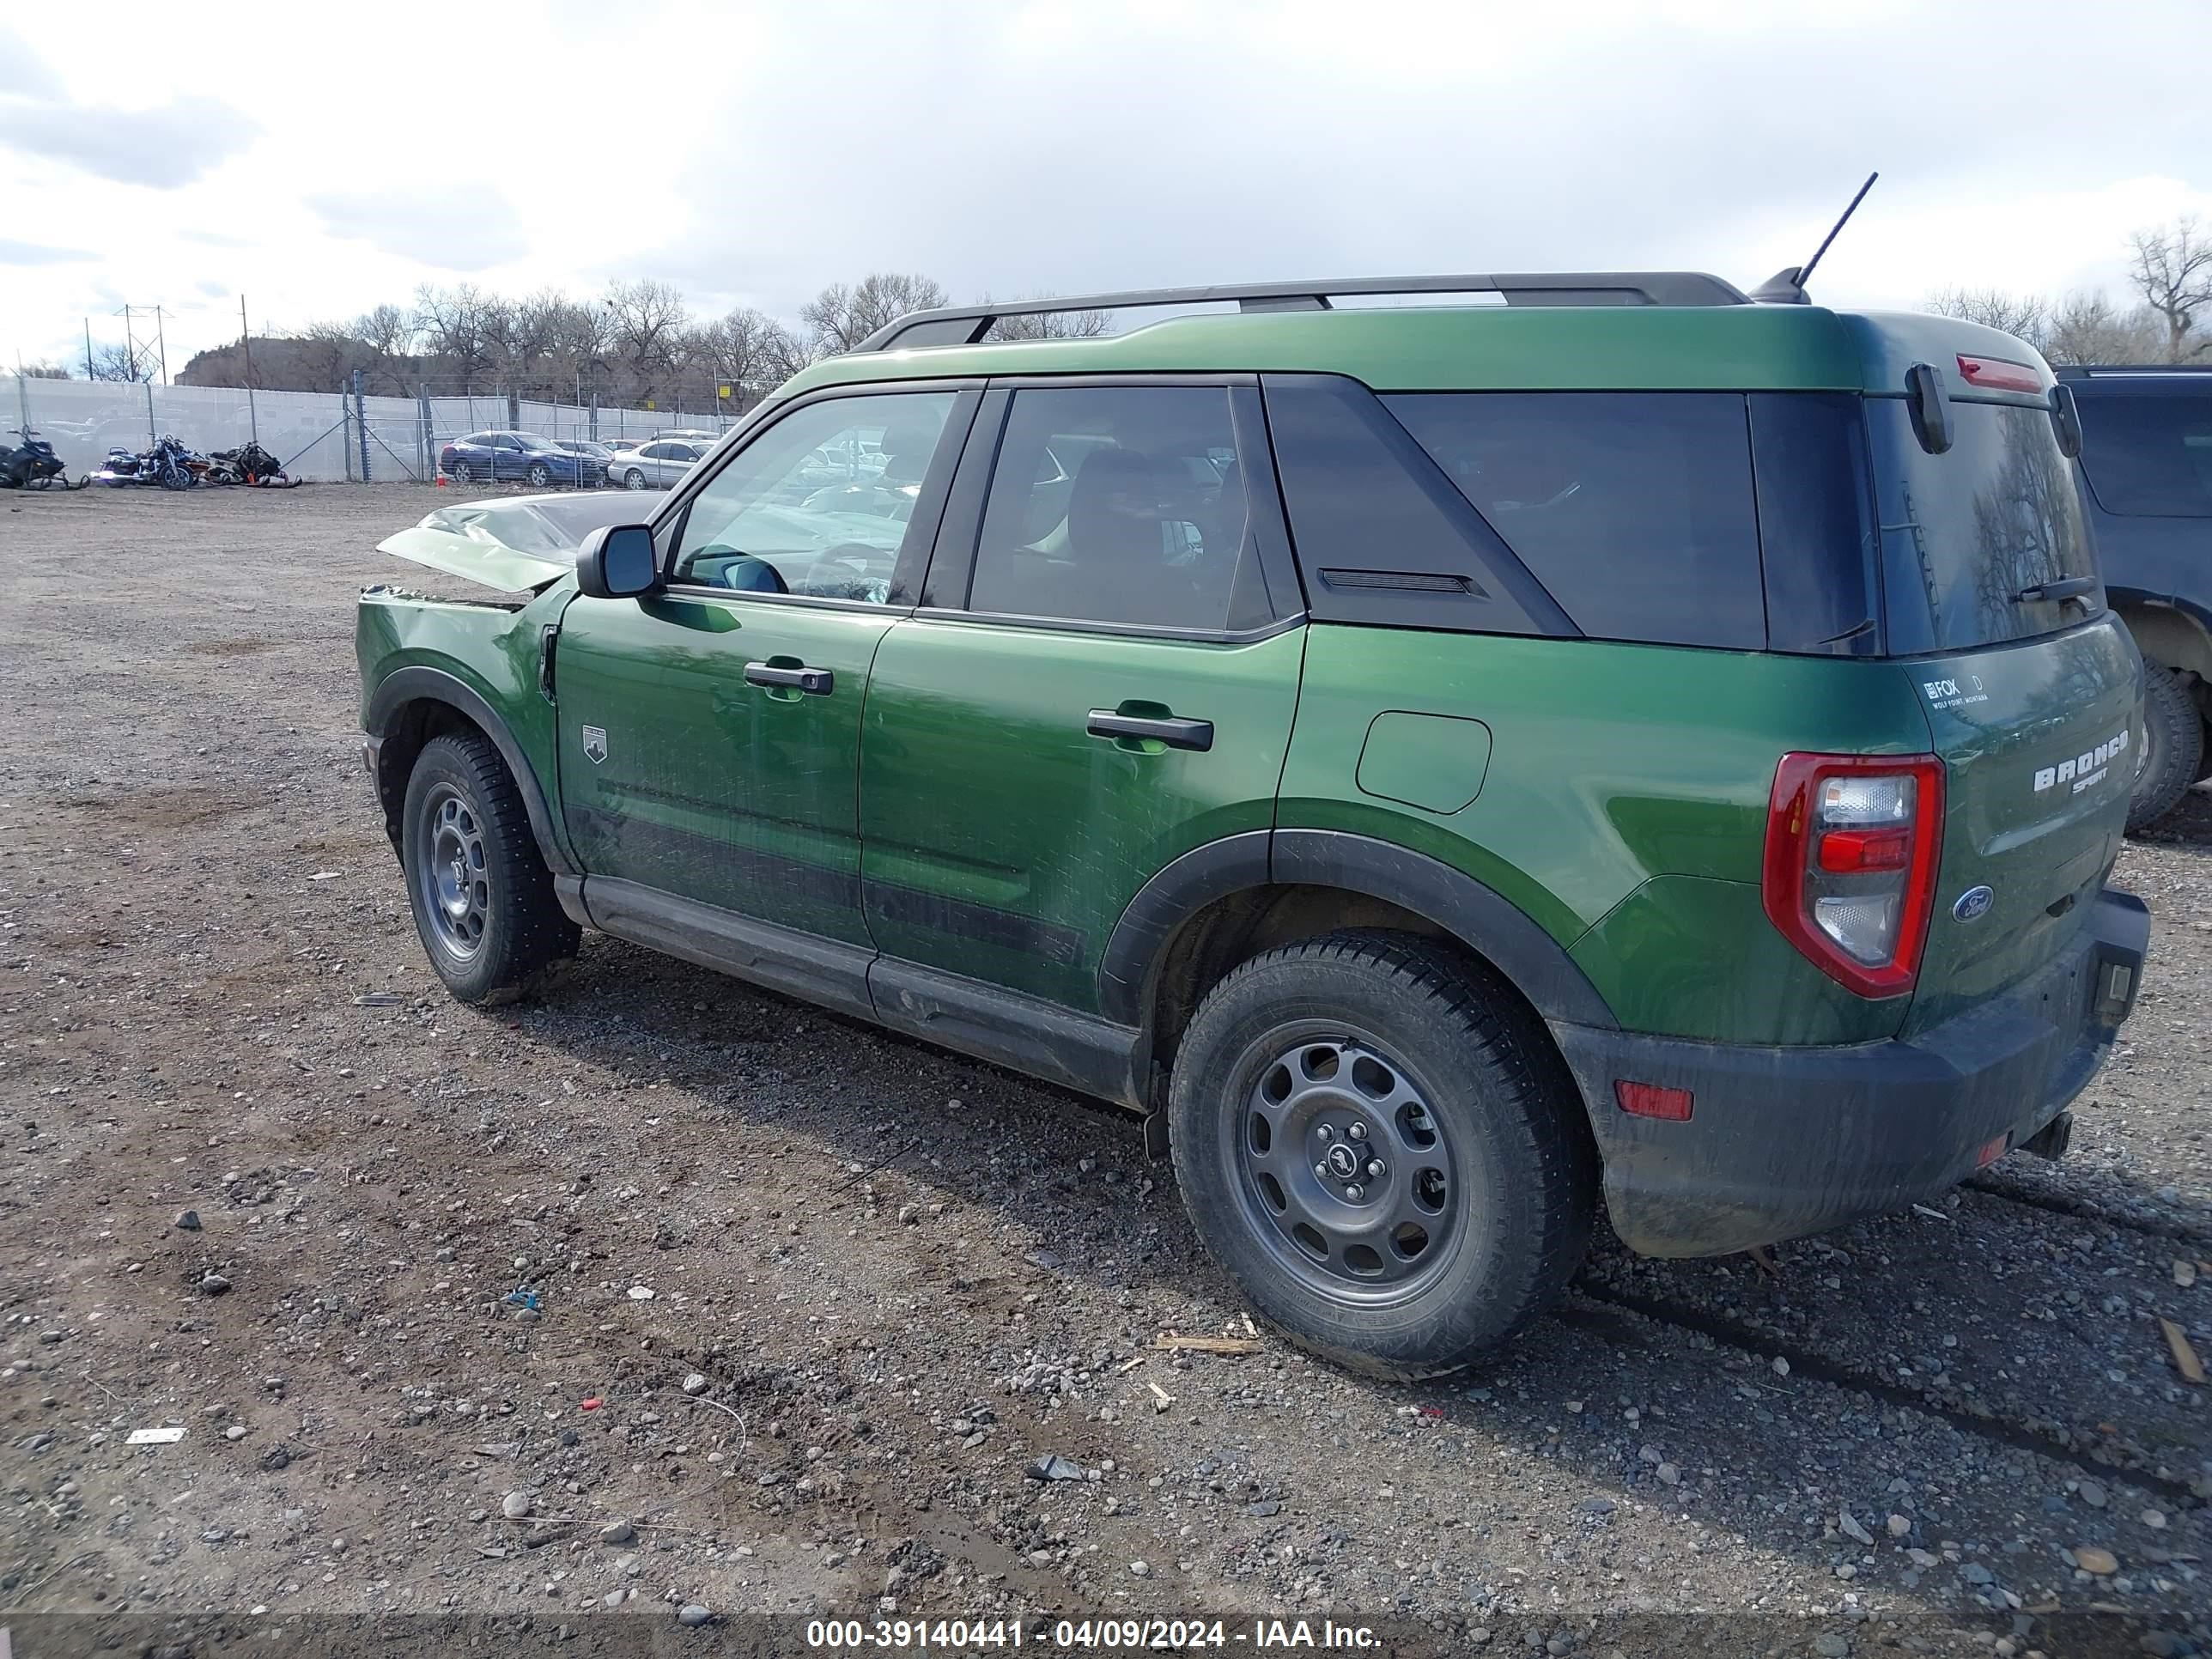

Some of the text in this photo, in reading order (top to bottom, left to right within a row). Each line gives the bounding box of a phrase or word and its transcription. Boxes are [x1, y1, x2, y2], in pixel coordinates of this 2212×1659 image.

[1935, 678, 1960, 697] FOX
[1933, 700, 1948, 709] WOLF
[1966, 694, 1988, 703] MONTANA
[2033, 729, 2129, 792] BRONCO
[2071, 767, 2109, 794] SPORT
